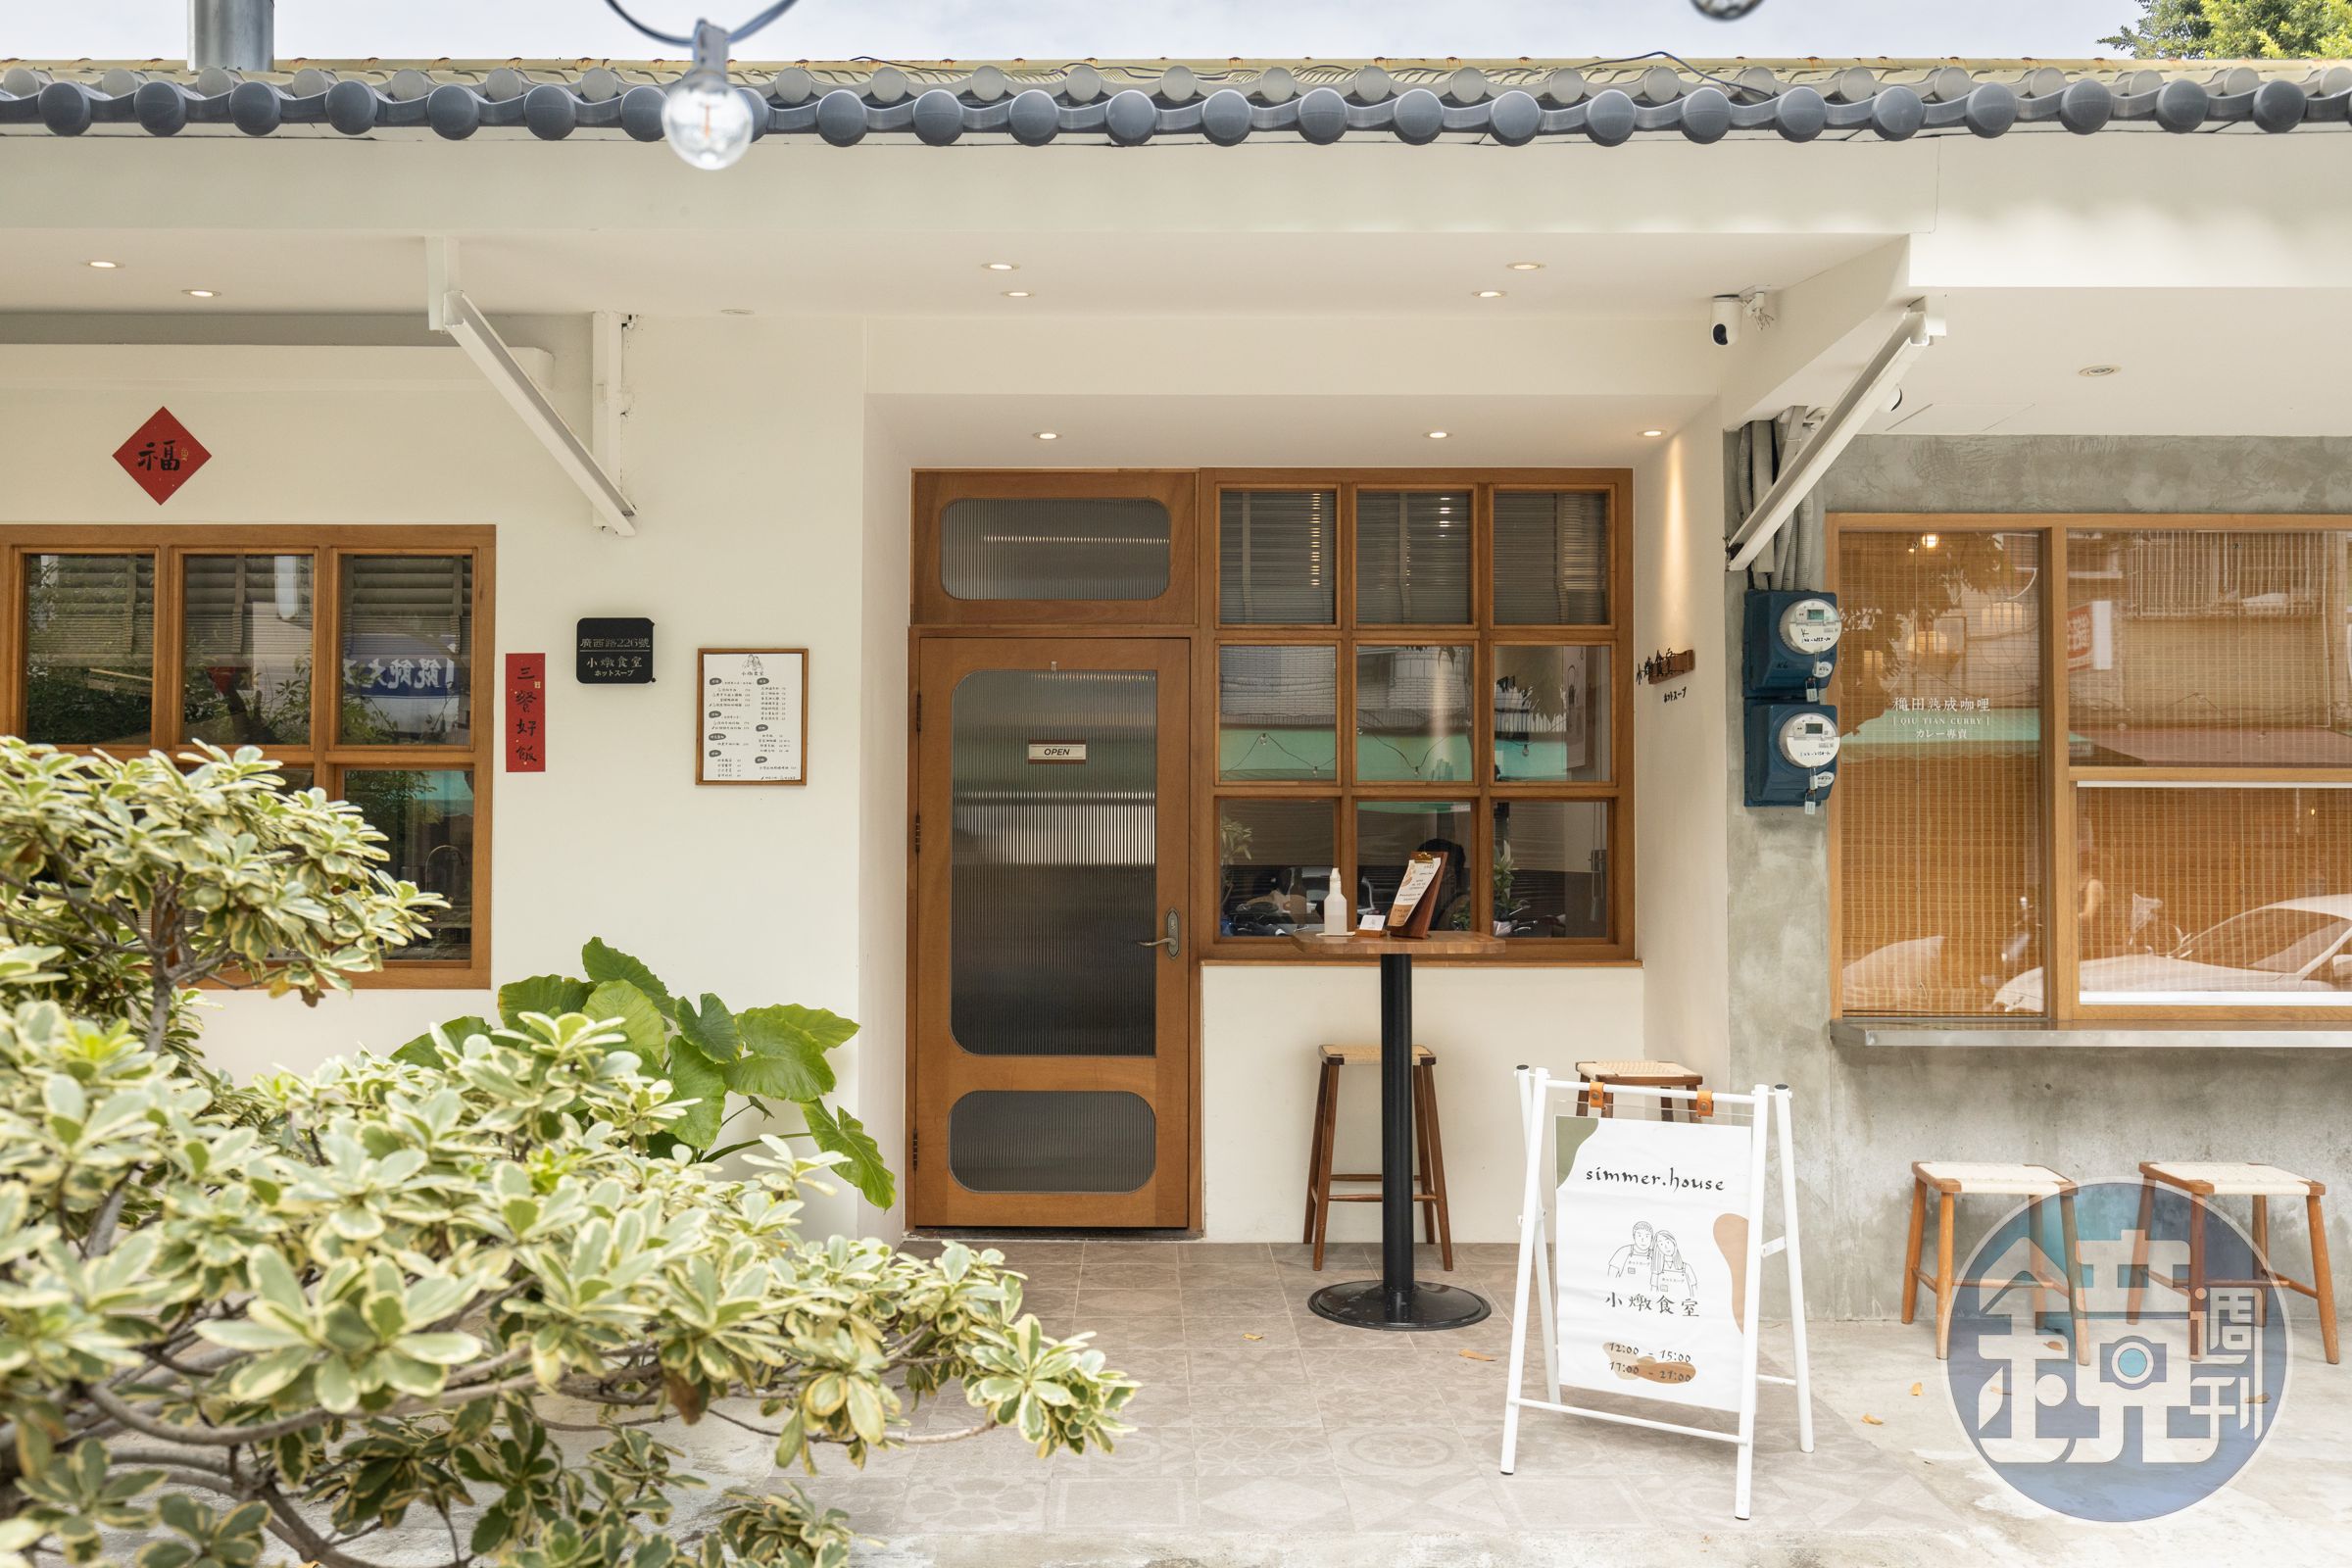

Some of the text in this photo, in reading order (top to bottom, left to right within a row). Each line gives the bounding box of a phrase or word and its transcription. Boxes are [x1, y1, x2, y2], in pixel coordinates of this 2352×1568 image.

[137, 439, 180, 471] 福
[586, 656, 643, 668] 小燉食室
[1044, 748, 1071, 757] OPEN
[1585, 1166, 1726, 1193] simmer.house
[1604, 1291, 1700, 1318] 小燉食室
[1608, 1342, 1640, 1355] 12:00
[1659, 1349, 1691, 1363] 15:00
[1608, 1361, 1640, 1374] 17:00
[1659, 1370, 1691, 1382] 21:00
